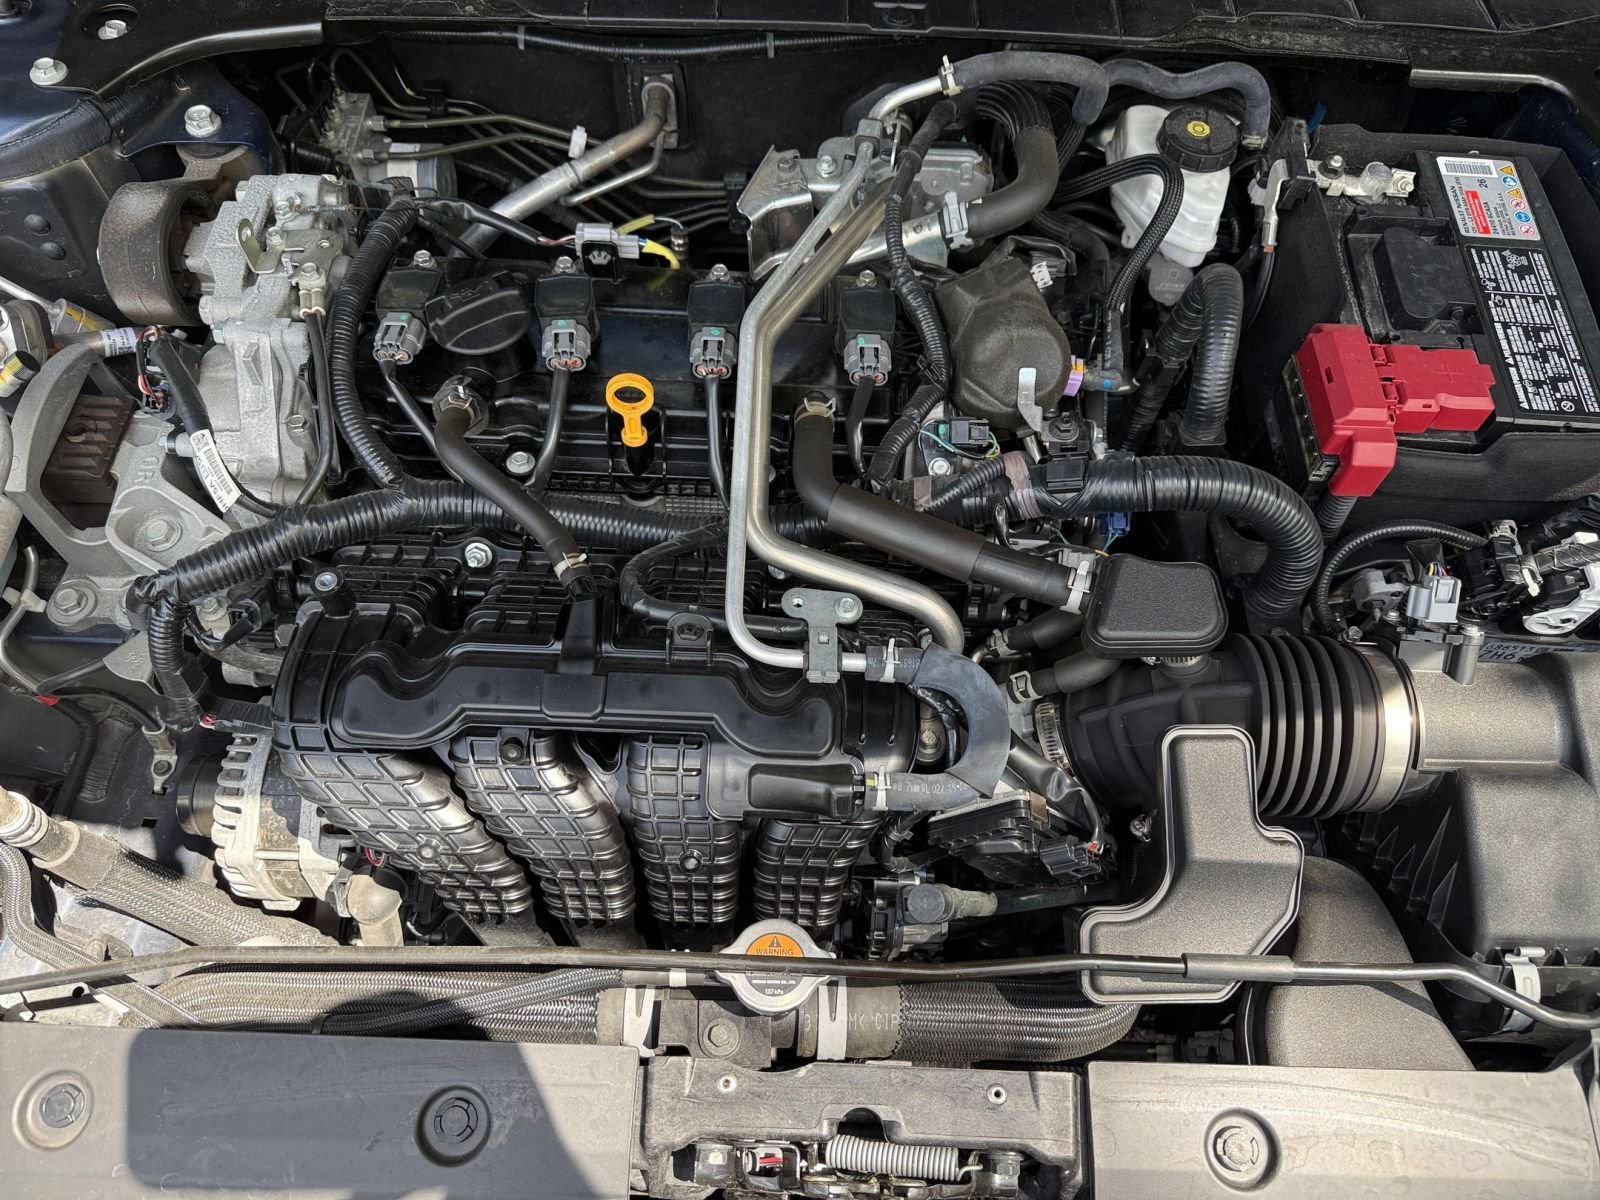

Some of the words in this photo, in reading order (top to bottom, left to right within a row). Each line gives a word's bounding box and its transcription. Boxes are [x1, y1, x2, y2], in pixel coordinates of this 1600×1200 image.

[1476, 178, 1488, 188] 26
[1449, 185, 1462, 208] NISSAN
[1457, 210, 1470, 233] RENAULT
[755, 948, 794, 956] WARNING
